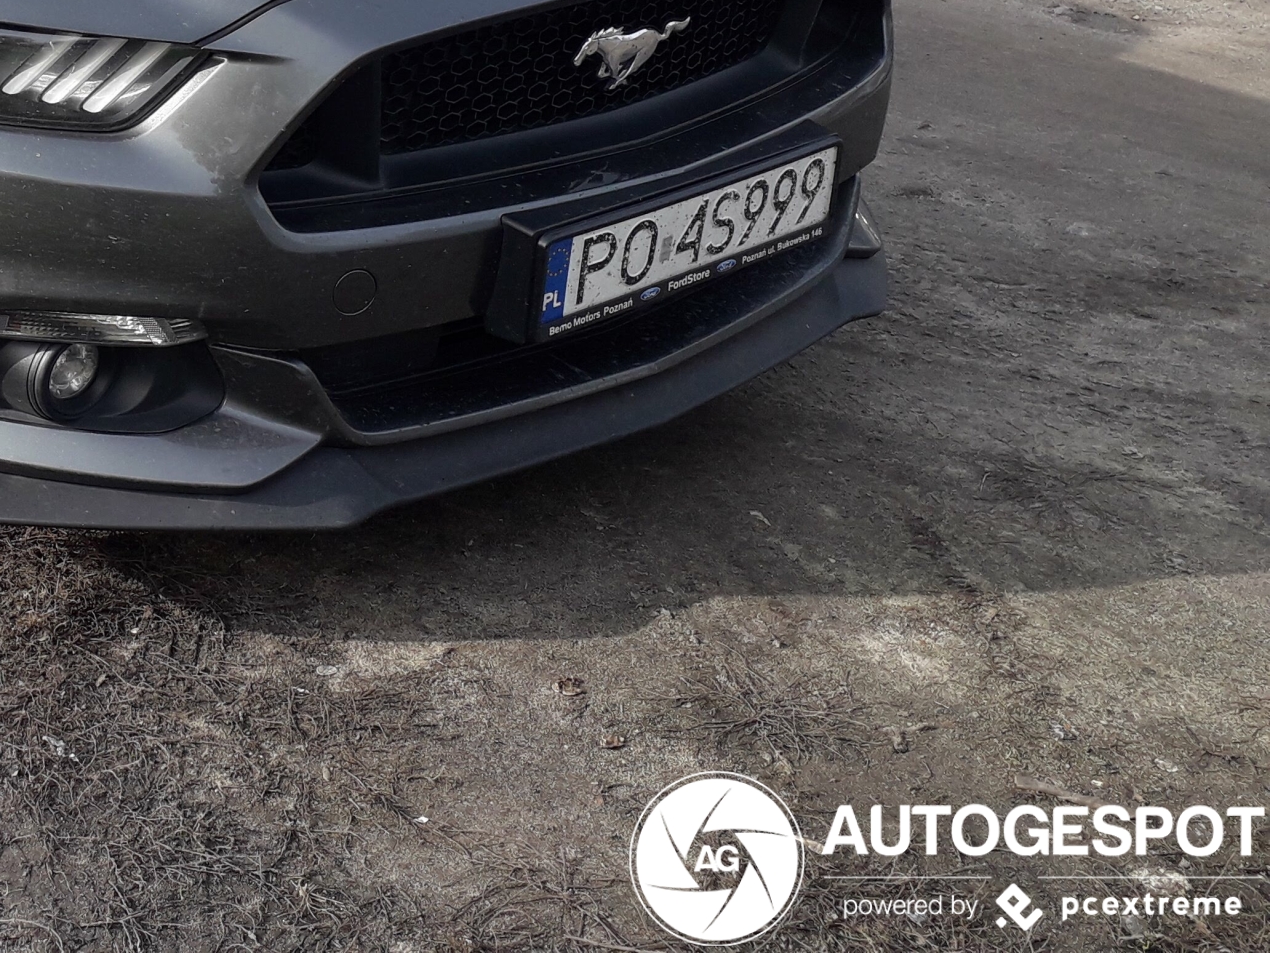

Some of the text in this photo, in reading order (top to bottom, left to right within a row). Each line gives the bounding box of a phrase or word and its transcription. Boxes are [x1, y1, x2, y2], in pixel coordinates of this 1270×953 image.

[549, 320, 572, 336] Bemo
[573, 310, 600, 327] Motors
[603, 298, 633, 316] Poznań
[668, 269, 710, 291] FordStore
[742, 249, 766, 264] Poznań
[768, 246, 776, 256] ul.
[777, 232, 810, 250] Bukowska
[811, 226, 822, 239] 146
[575, 157, 826, 305] PO 4S999
[542, 291, 562, 312] PL
